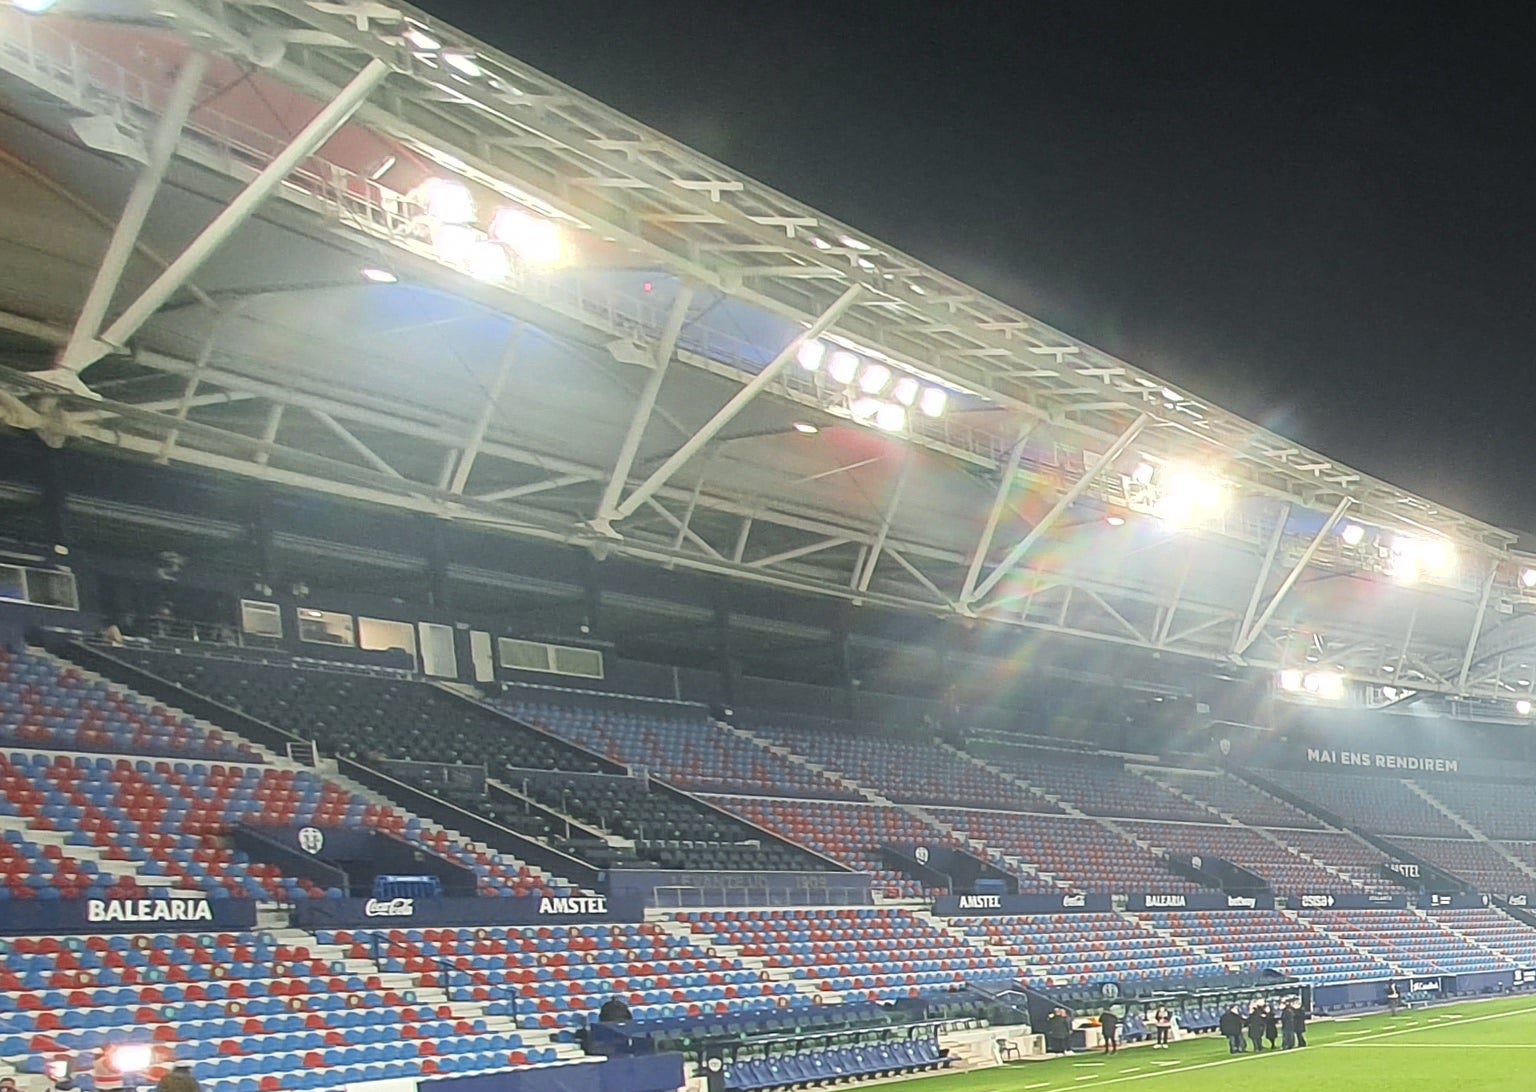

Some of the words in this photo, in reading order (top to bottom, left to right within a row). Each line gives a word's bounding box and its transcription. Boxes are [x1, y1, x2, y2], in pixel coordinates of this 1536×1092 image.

[1307, 749, 1337, 763] MAI
[1341, 751, 1372, 766] ENS
[1375, 754, 1459, 772] RENDIREM
[87, 899, 213, 922] BALEARIA
[539, 897, 608, 914] AMSTEL
[959, 895, 1001, 909] AMSTEL
